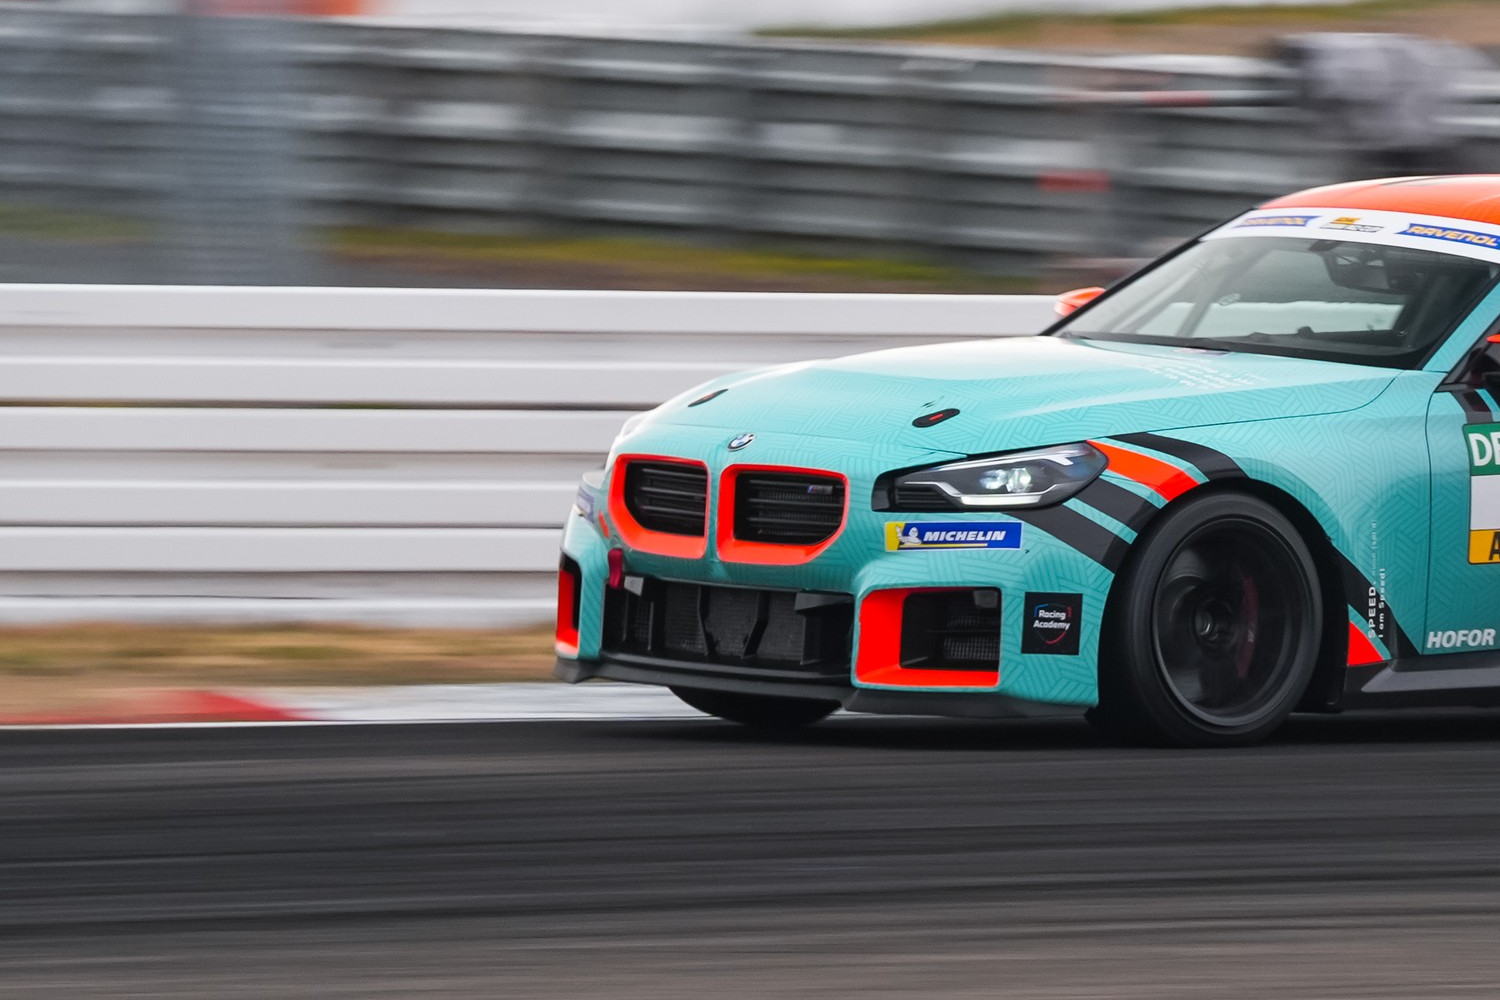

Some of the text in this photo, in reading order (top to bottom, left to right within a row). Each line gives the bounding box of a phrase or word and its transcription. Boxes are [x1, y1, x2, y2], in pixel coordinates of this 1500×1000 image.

[1407, 226, 1499, 247] RAVENOL
[923, 531, 1006, 542] MICHELIN
[1039, 610, 1066, 620] Racing
[1033, 620, 1071, 630] Academy
[1426, 629, 1496, 648] HOFOR
